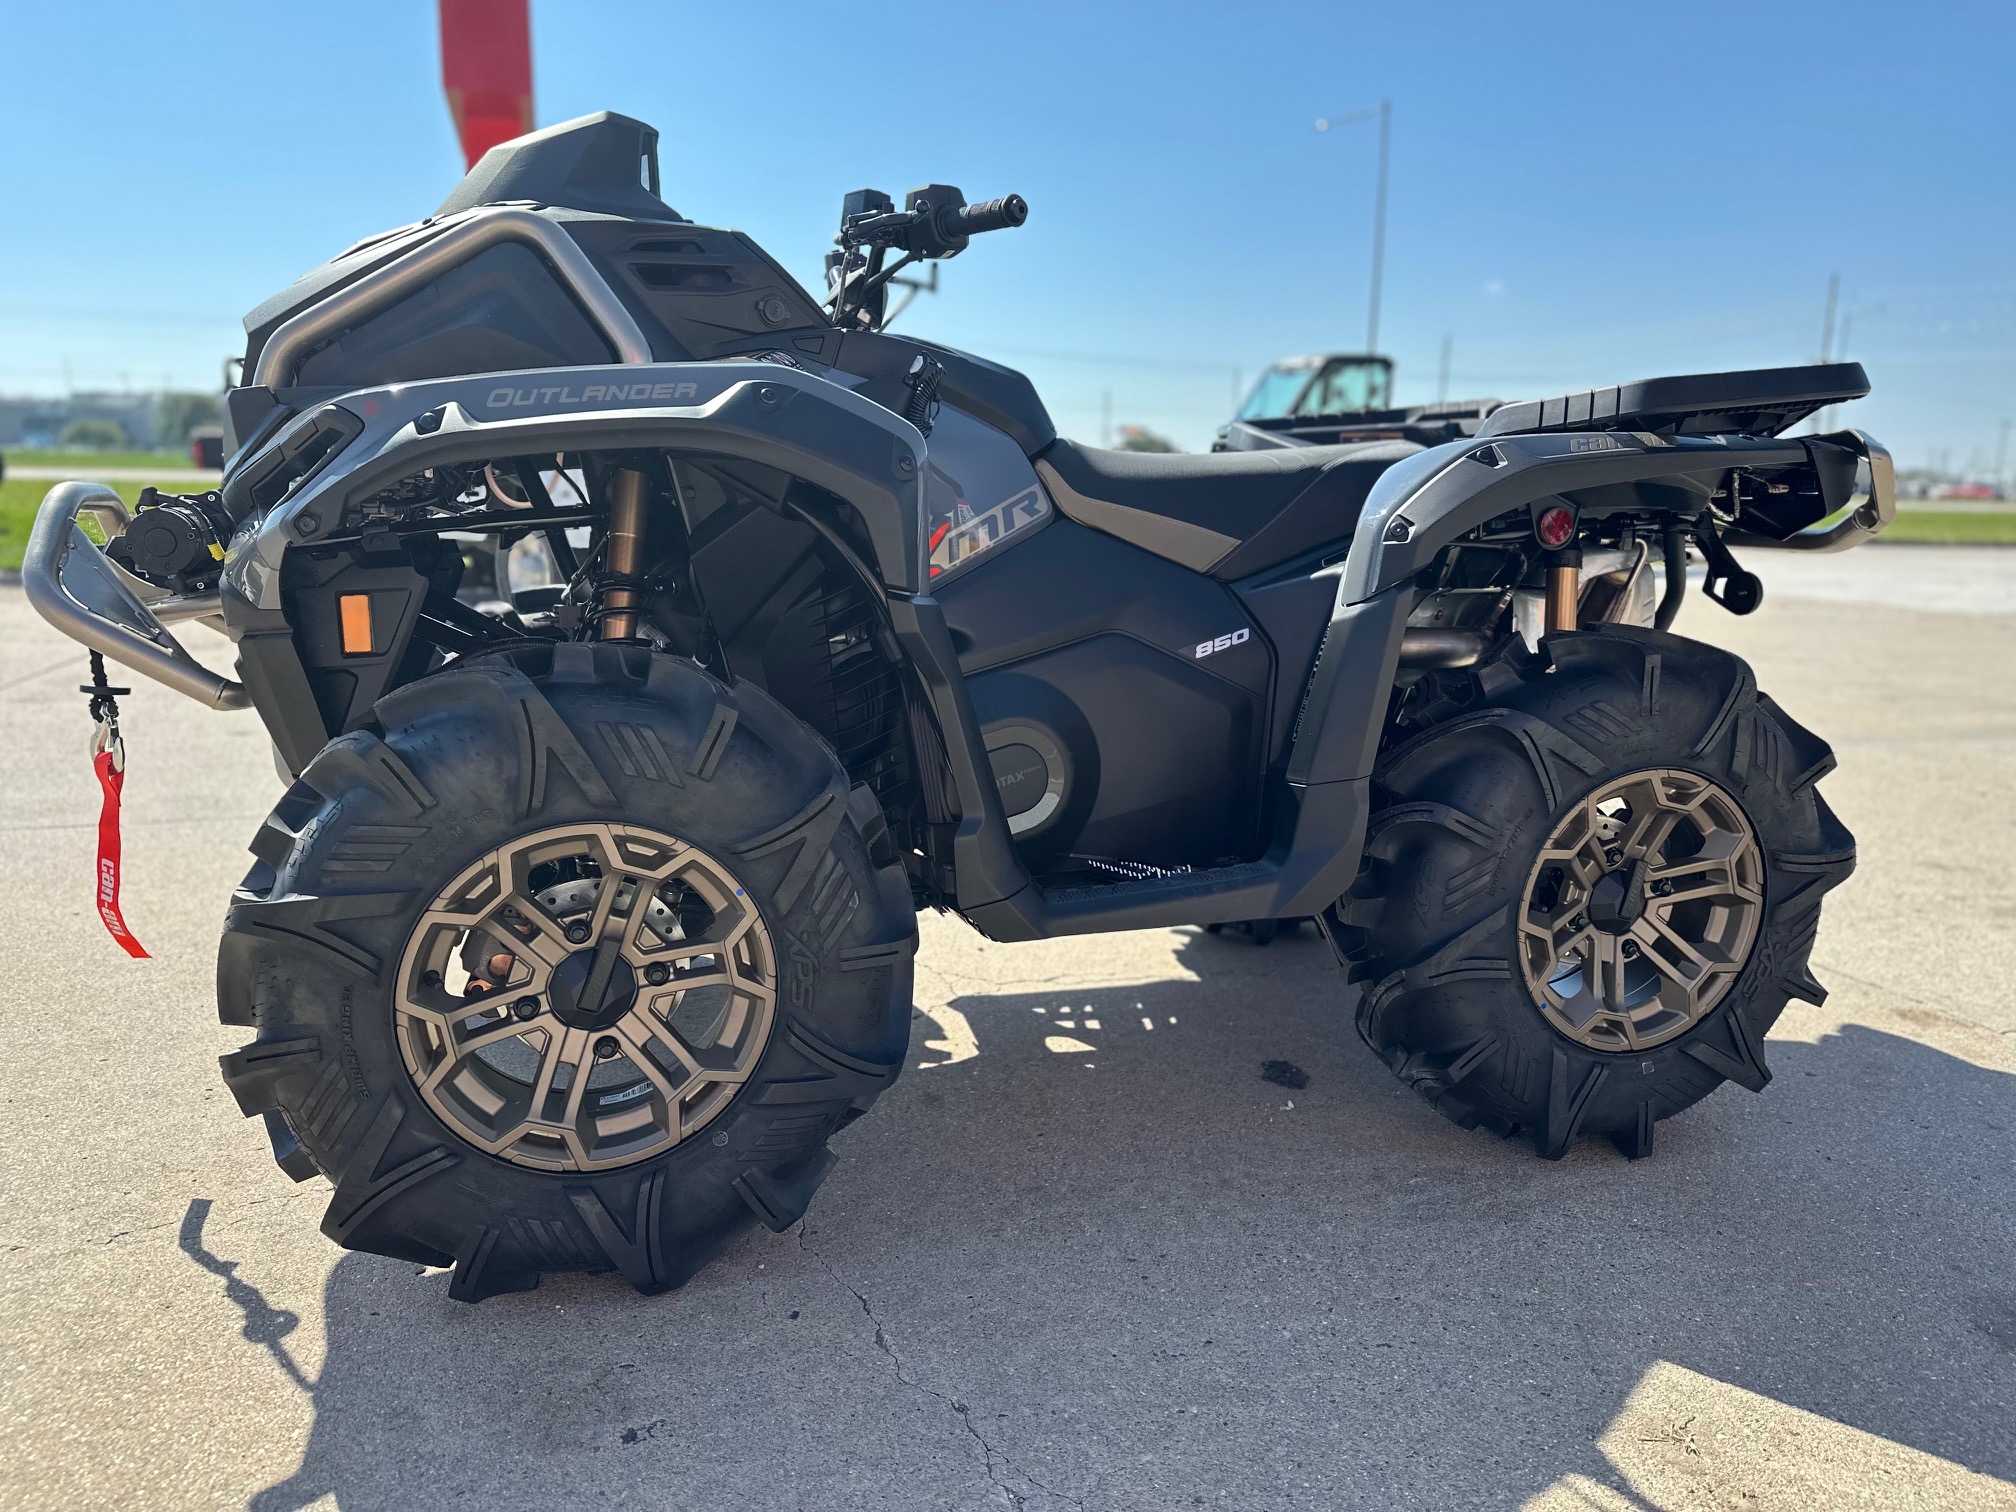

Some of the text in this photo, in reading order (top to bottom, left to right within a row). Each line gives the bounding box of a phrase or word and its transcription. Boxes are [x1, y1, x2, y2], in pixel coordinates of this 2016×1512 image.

[486, 382, 698, 408] OUTLANDER
[1194, 628, 1250, 659] 850
[995, 770, 1025, 787] TAX
[101, 858, 126, 937] can-am
